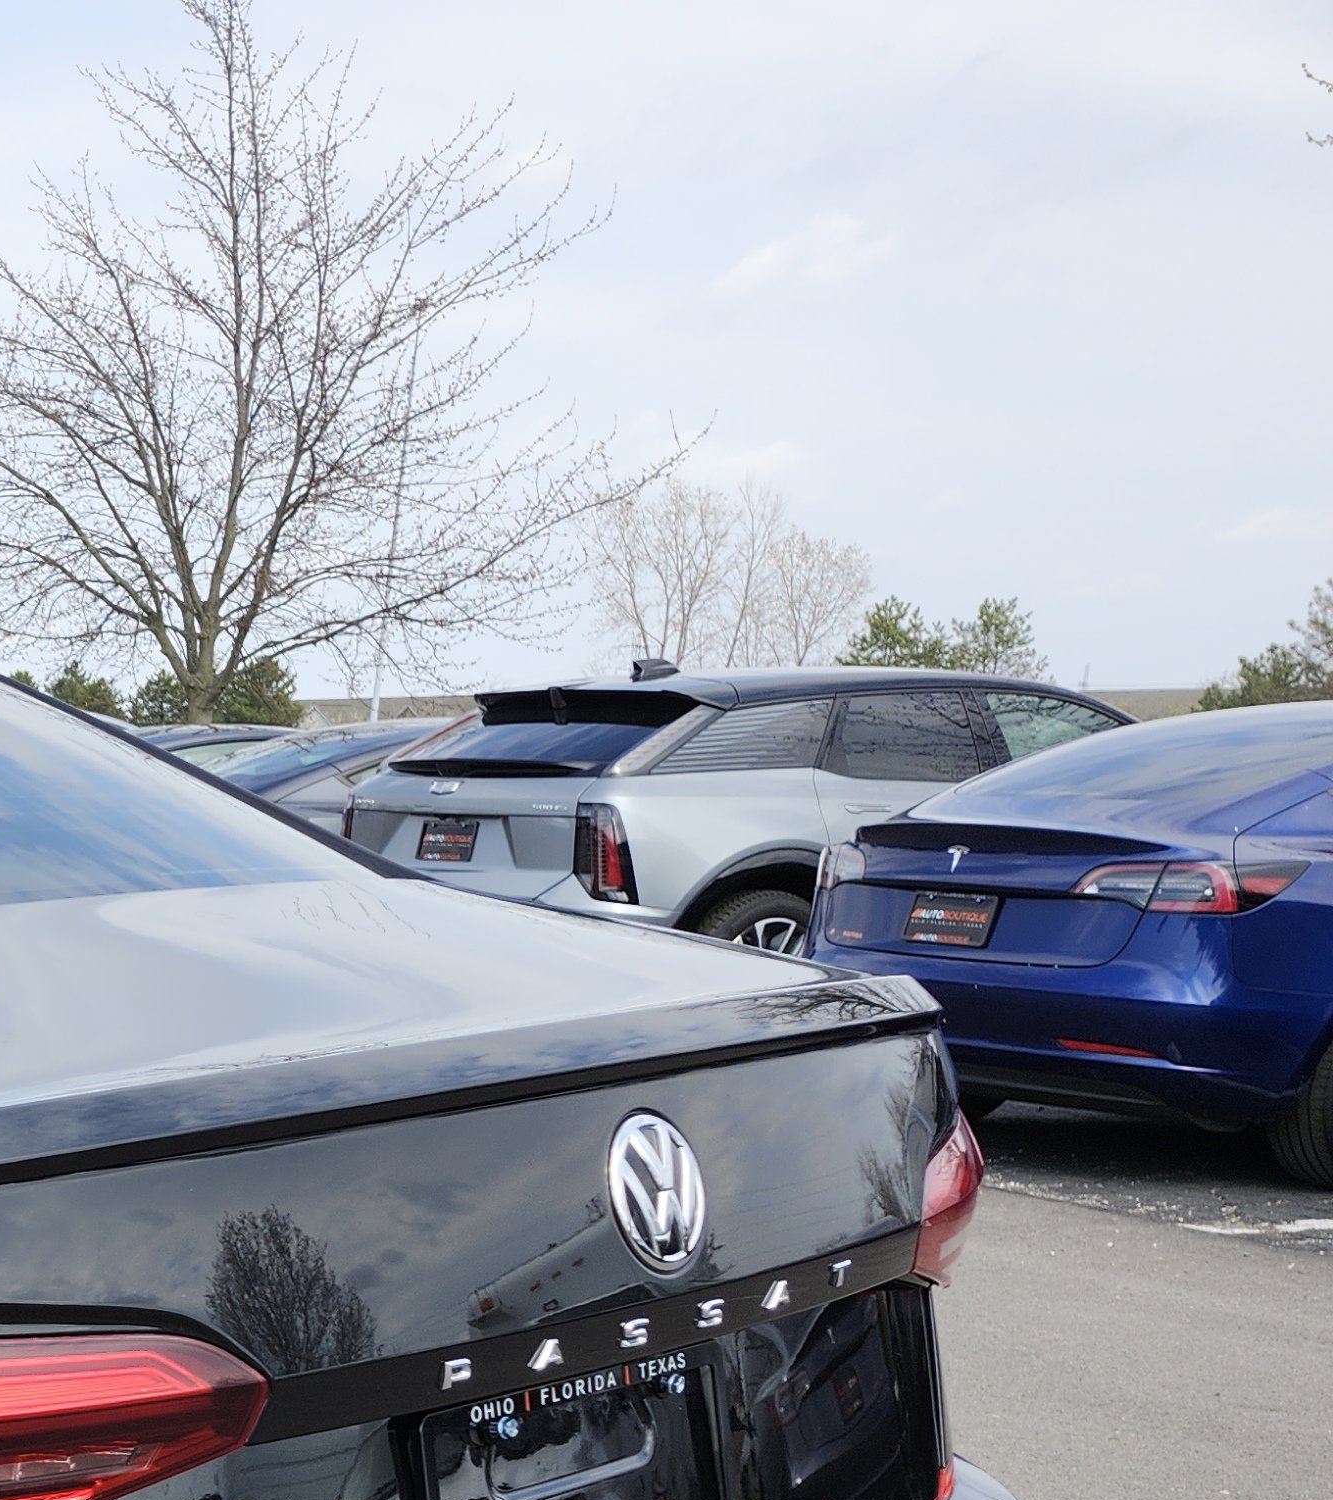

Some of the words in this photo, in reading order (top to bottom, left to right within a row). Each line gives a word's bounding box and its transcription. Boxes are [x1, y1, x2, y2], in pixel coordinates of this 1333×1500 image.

[920, 909, 989, 923] AUTOBOUTIQUE
[441, 1258, 853, 1390] PASSAT
[470, 1398, 515, 1423] OHIO
[540, 1371, 617, 1406] FLORIDA
[638, 1352, 686, 1380] TEXAS
